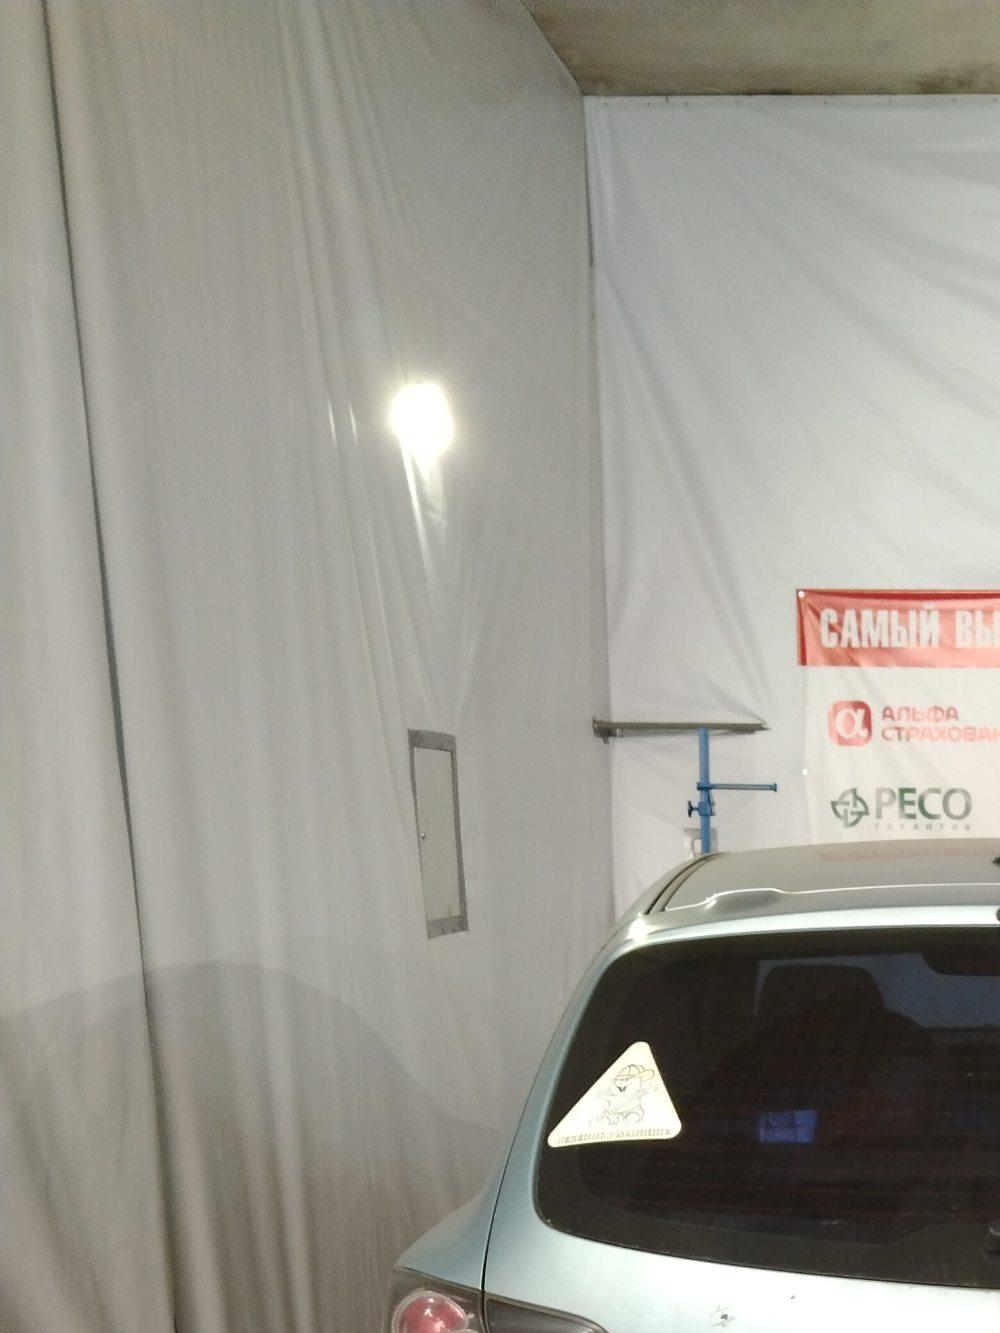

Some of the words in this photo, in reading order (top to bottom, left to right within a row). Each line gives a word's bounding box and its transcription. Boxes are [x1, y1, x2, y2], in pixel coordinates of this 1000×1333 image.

[820, 603, 940, 649] САМЫЙ
[882, 705, 960, 722] АЛЬФА
[874, 787, 973, 820] РЕСО
